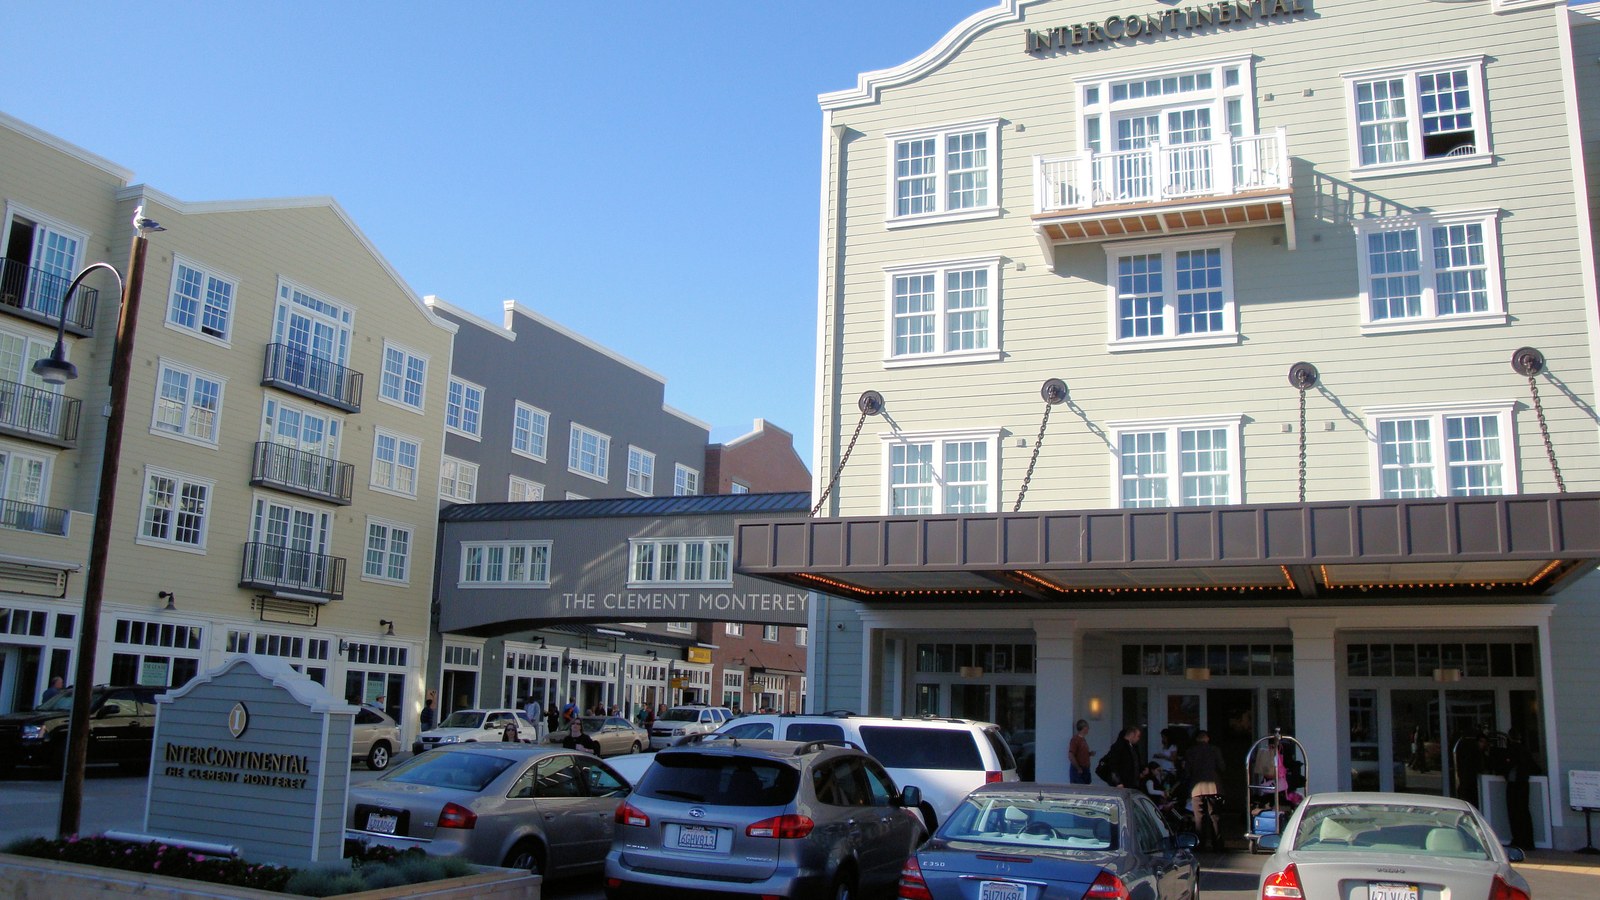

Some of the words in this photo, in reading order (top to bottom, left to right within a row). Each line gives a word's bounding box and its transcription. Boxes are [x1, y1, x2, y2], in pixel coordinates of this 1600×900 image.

[563, 593, 595, 609] THE
[603, 593, 690, 609] CLEMENT
[699, 593, 809, 610] MONTEREY
[165, 742, 309, 774] INTERCONTINENTAL
[165, 766, 184, 777] THE
[188, 769, 239, 782] CLEMENT
[243, 774, 307, 789] MONTEREY
